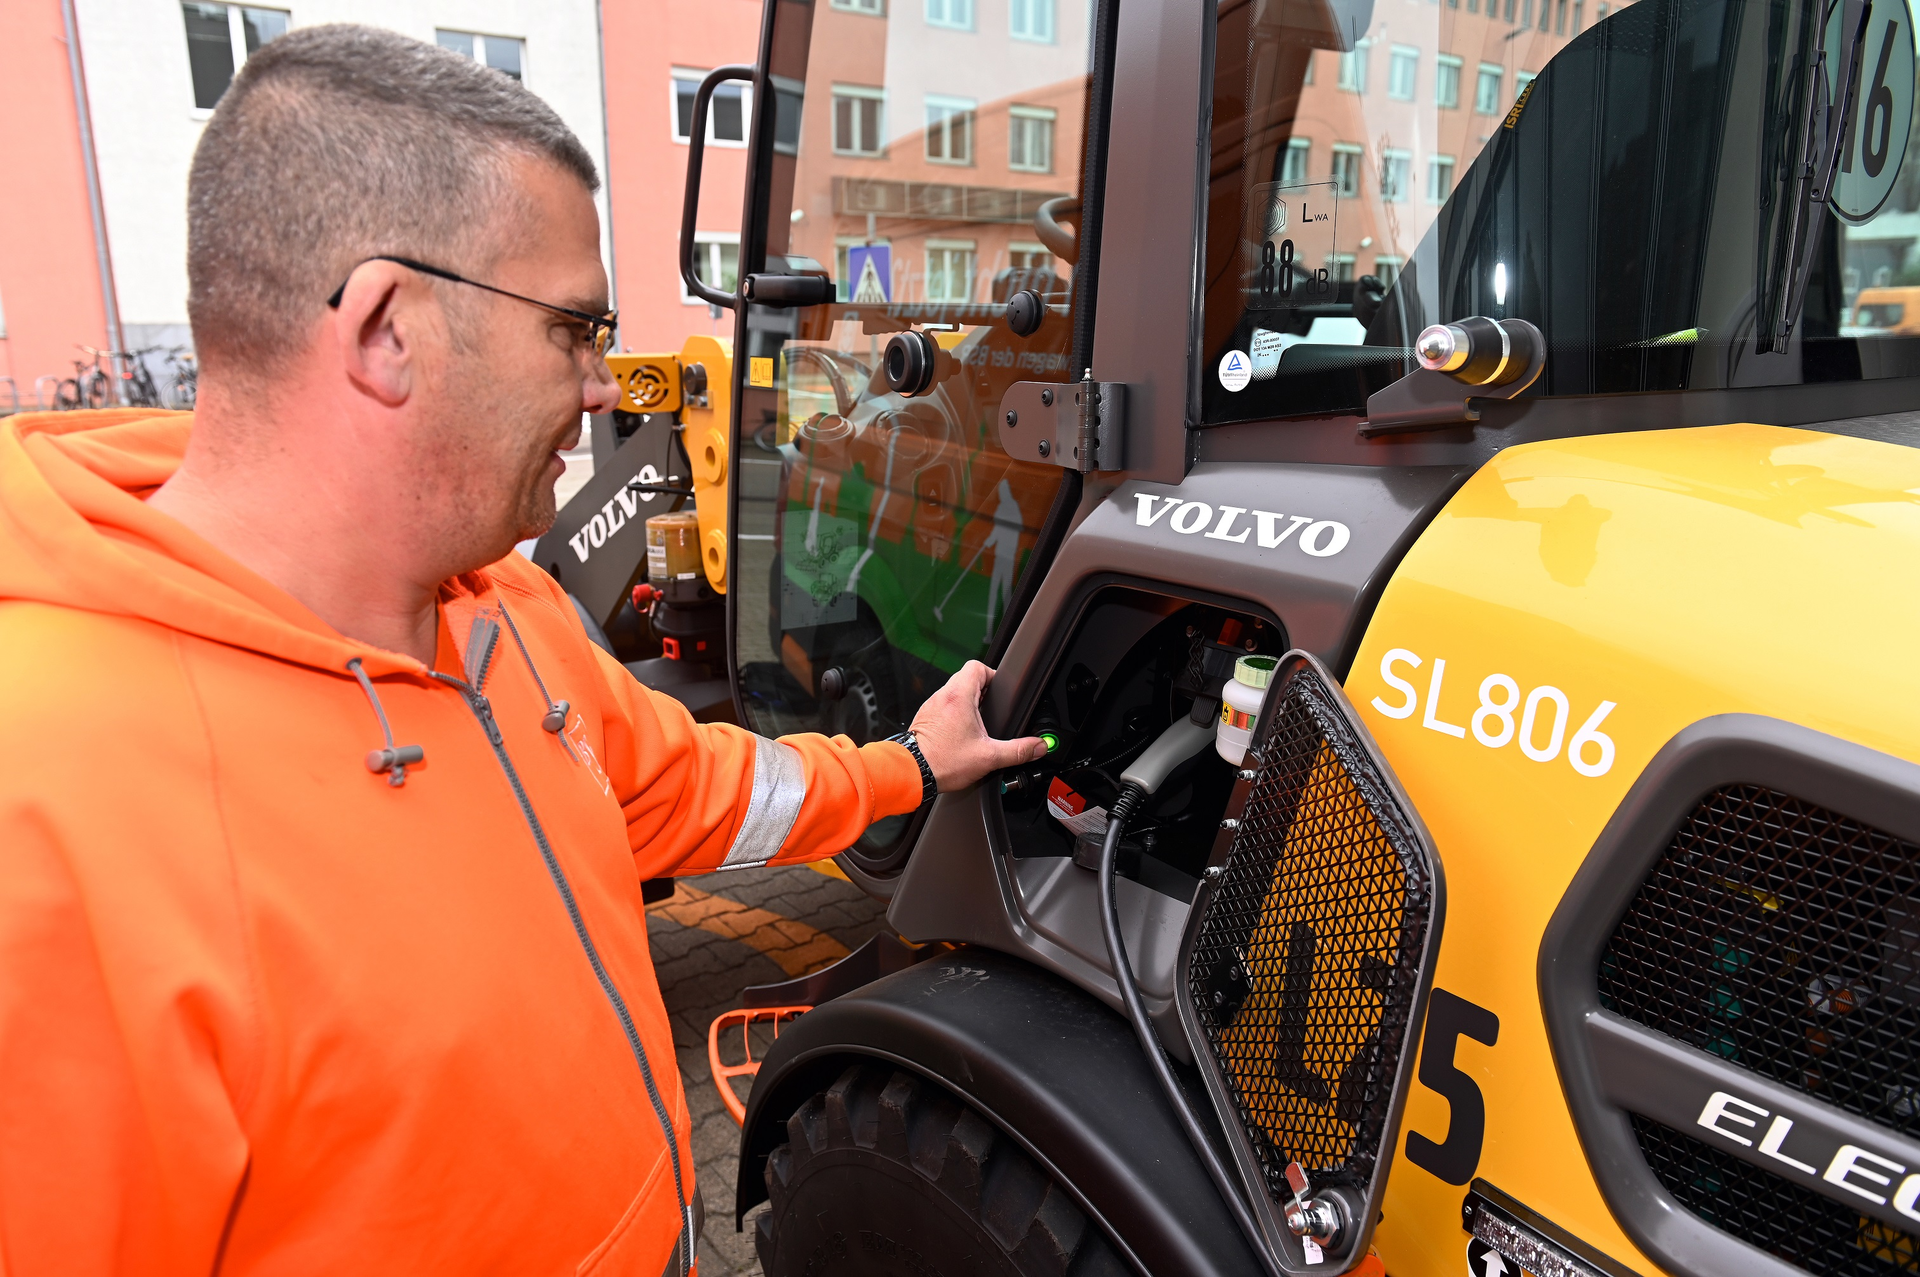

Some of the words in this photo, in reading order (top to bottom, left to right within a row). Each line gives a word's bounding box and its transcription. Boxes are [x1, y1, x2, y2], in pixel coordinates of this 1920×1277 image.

[1504, 103, 1524, 129] ISRI
[1261, 239, 1295, 298] 88
[1306, 268, 1330, 295] dB
[568, 464, 658, 563] VOLVO
[1133, 492, 1351, 557] VOLVO
[1370, 648, 1618, 777] SL806
